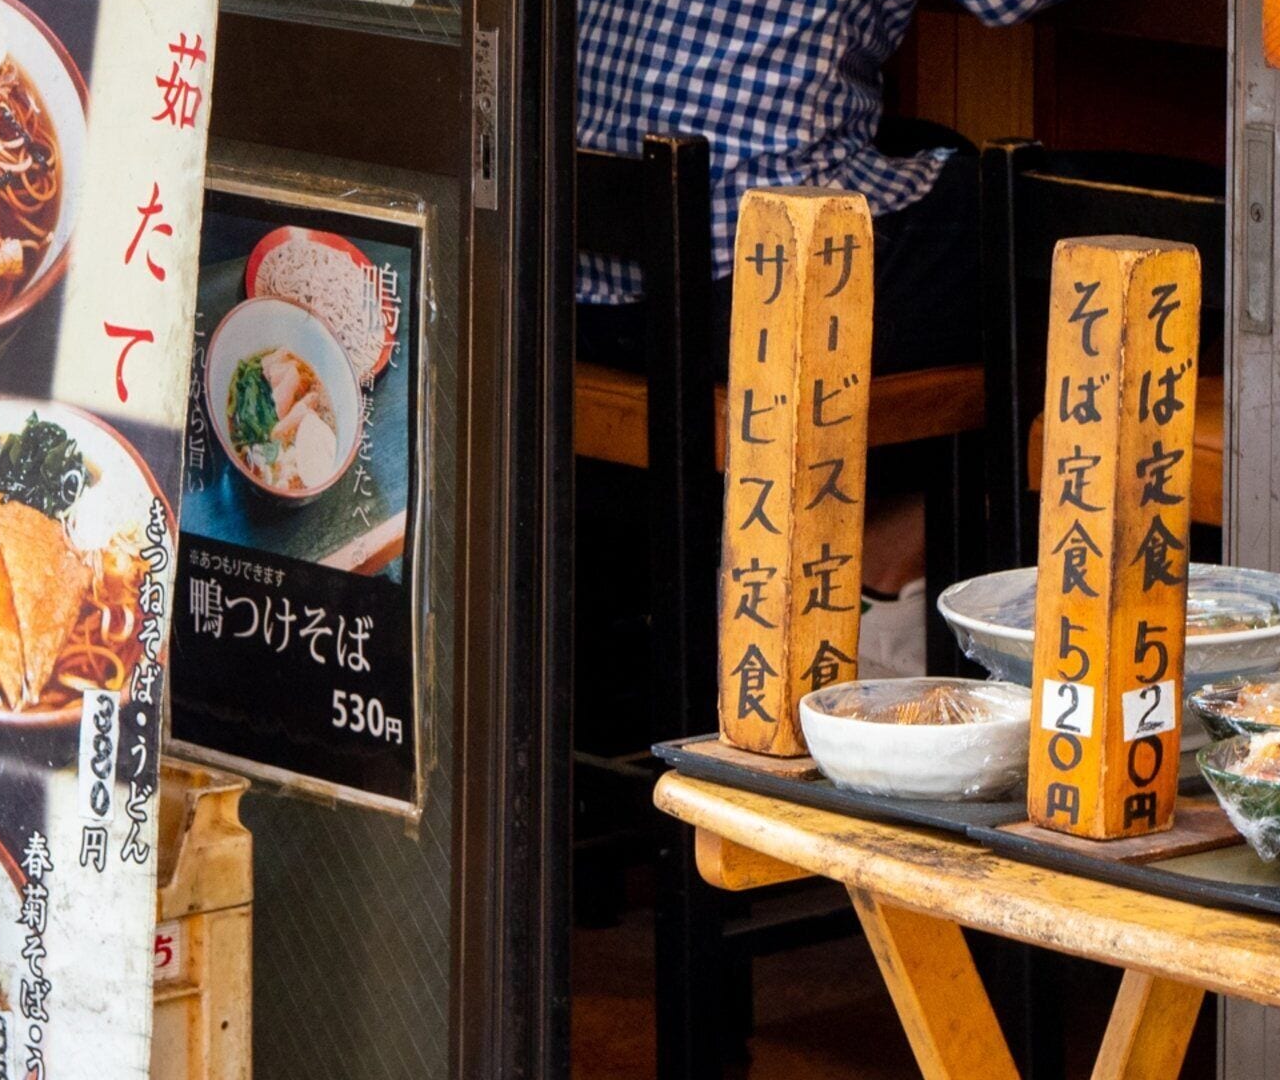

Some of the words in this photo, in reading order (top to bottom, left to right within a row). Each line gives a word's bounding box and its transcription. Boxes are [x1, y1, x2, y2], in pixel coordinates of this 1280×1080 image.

[728, 242, 789, 722] サービス定食
[189, 576, 374, 672] 鴨つけそば
[331, 688, 403, 744] 530円
